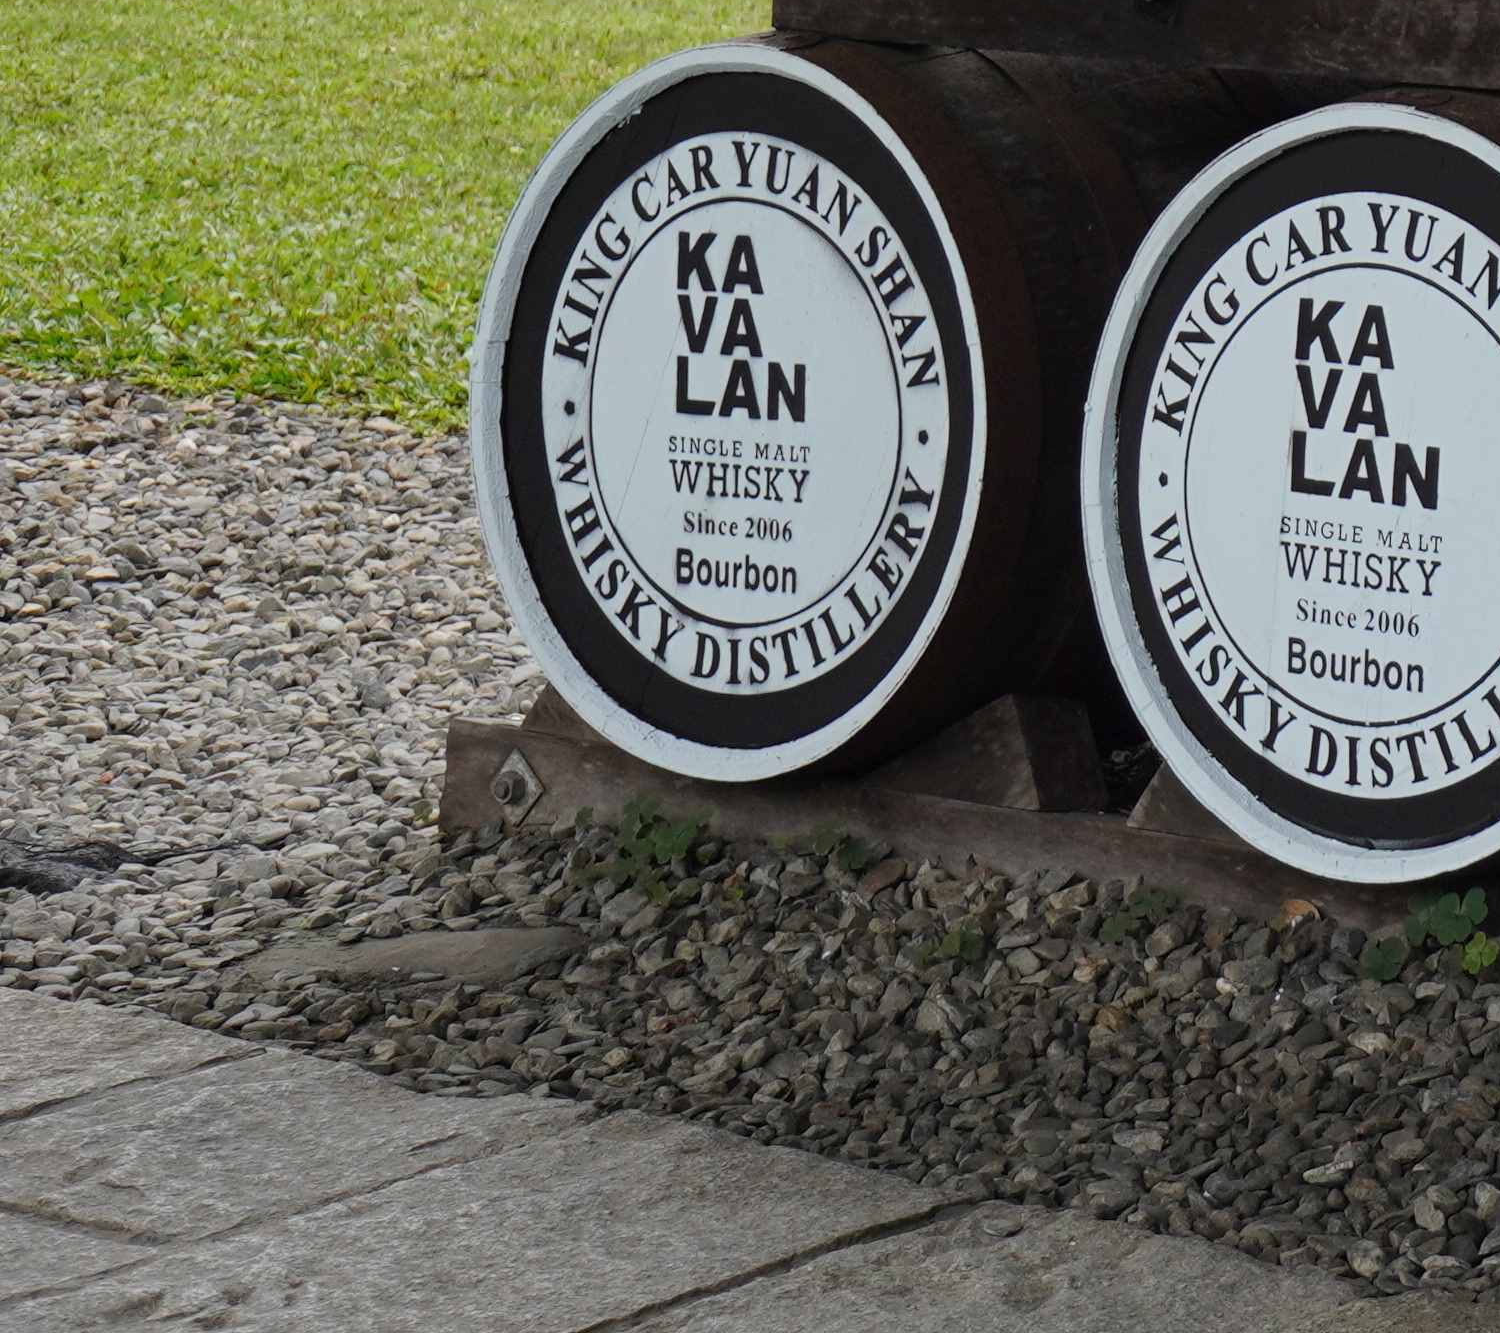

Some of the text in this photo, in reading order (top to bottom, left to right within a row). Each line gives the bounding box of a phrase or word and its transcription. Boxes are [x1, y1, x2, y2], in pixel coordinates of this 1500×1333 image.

[553, 141, 940, 387] KING CAR YUAN SHAN
[677, 232, 764, 294] KA
[678, 295, 763, 357] VA
[1152, 273, 1239, 437] KING
[1246, 206, 1352, 286] CAR
[1295, 298, 1394, 369] KA
[676, 356, 806, 422] LAN
[1296, 364, 1389, 437] VA
[669, 436, 809, 462] SINGLE MALT
[1291, 430, 1440, 510] LAN
[669, 459, 809, 503] WHISKY
[684, 512, 792, 541] Since 2006
[1280, 517, 1442, 553] SINGLE MALT
[556, 437, 934, 685] WHISKY DISTILLERY
[676, 548, 796, 594] Bourbon
[1280, 541, 1441, 596] WHISKY
[1151, 513, 1297, 753] WHISKY
[1298, 599, 1419, 637] Since 2006
[1288, 637, 1423, 692] Bourbon
